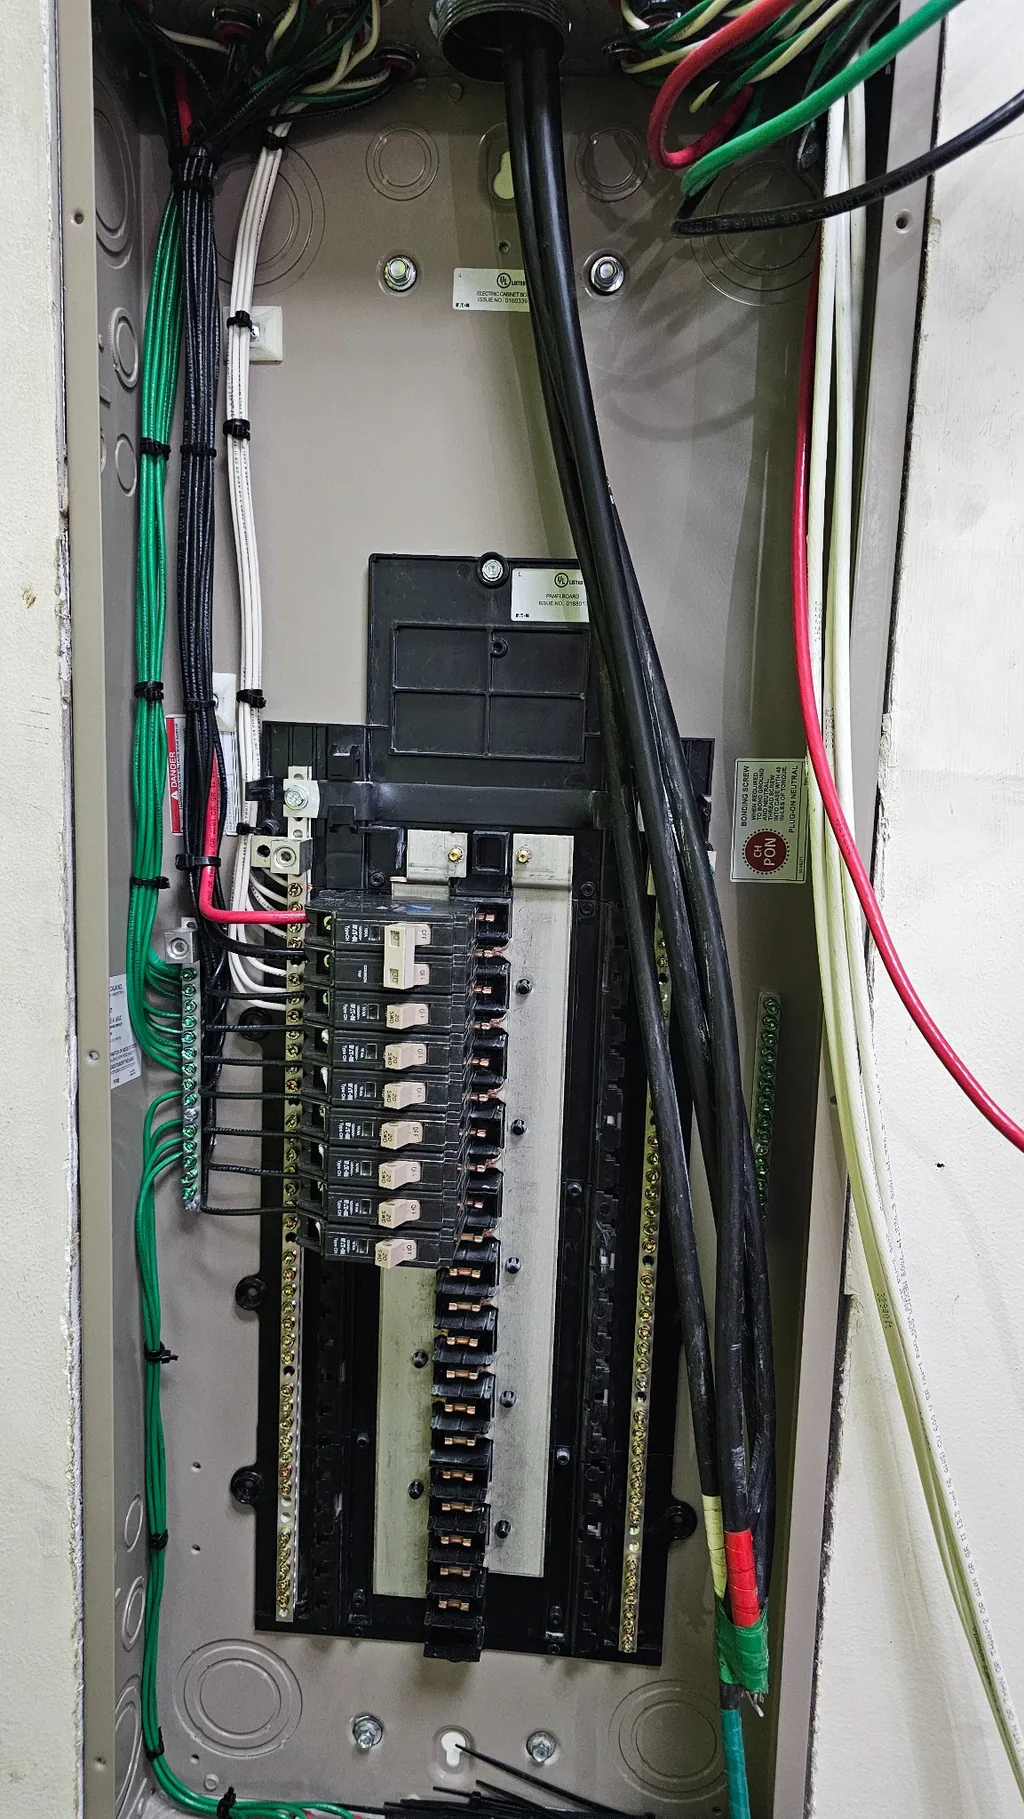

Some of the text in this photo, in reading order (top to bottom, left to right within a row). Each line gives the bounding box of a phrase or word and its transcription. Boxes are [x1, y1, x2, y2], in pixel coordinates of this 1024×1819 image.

[169, 752, 178, 788] DANGER
[790, 766, 798, 800] NEUTRAL
[781, 790, 785, 800] OF
[754, 845, 762, 858] CH
[764, 838, 776, 866] PON
[392, 973, 398, 983] 30
